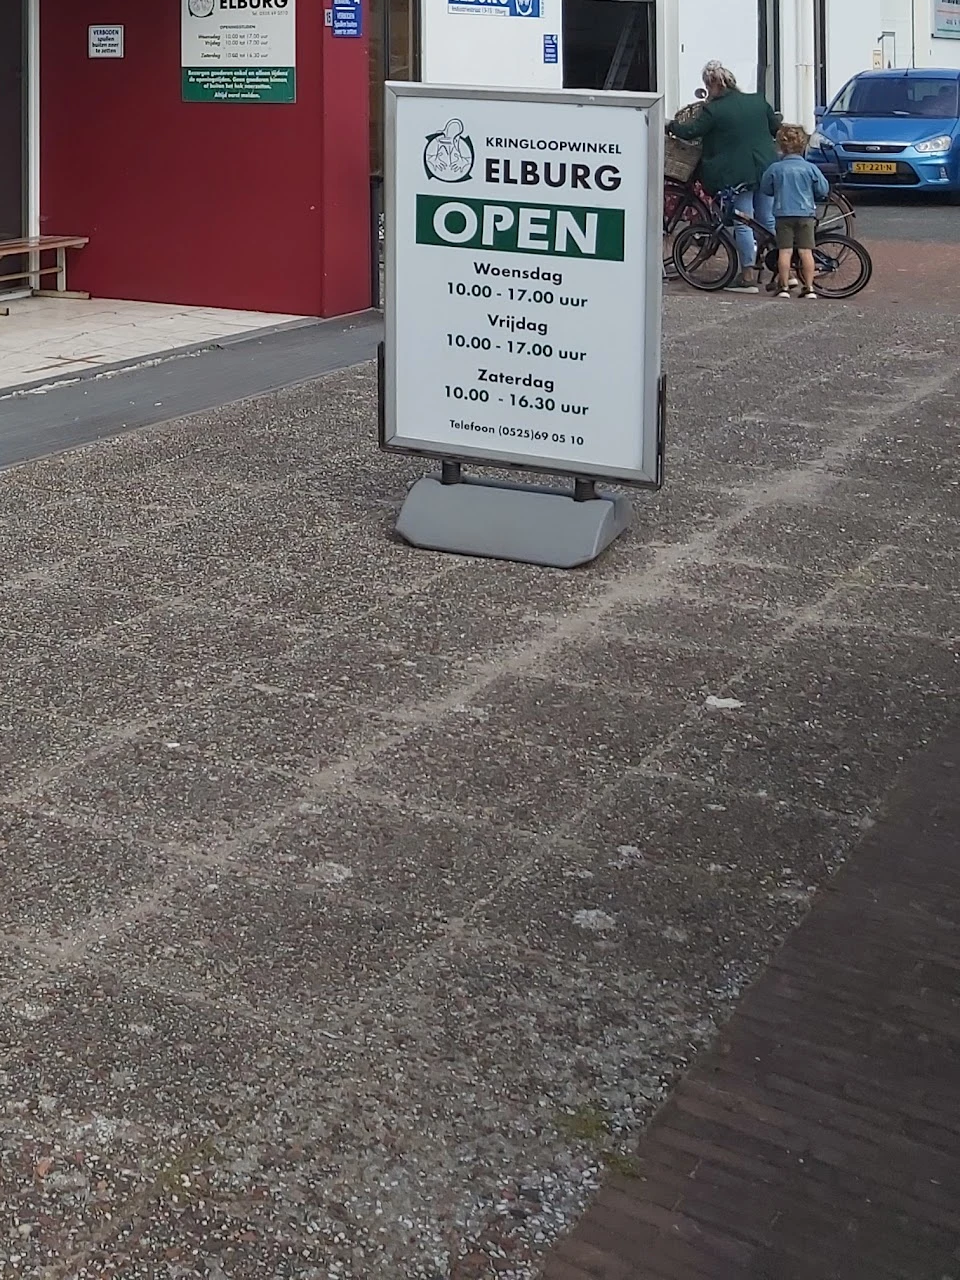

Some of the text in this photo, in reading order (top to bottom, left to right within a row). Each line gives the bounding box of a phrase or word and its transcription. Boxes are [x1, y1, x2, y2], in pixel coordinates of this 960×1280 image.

[485, 136, 622, 155] KRINGLOOPWINKEL
[485, 158, 622, 191] ELBURG
[433, 201, 598, 255] OPEN
[474, 262, 563, 286] Woensdag
[447, 282, 492, 298] 10.00
[508, 288, 554, 305] 17.00
[559, 294, 588, 308] uur
[487, 314, 549, 336] Vrijdag
[447, 334, 491, 351] 10.00
[507, 341, 553, 358] 17.00
[558, 347, 587, 361] uur
[477, 369, 555, 393] Zaterdag
[445, 385, 489, 403] 10.00
[510, 394, 556, 411] 16.30
[560, 401, 589, 416] uur
[450, 420, 496, 435] Telefoon
[552, 432, 566, 444] 05
[570, 435, 584, 446] 10
